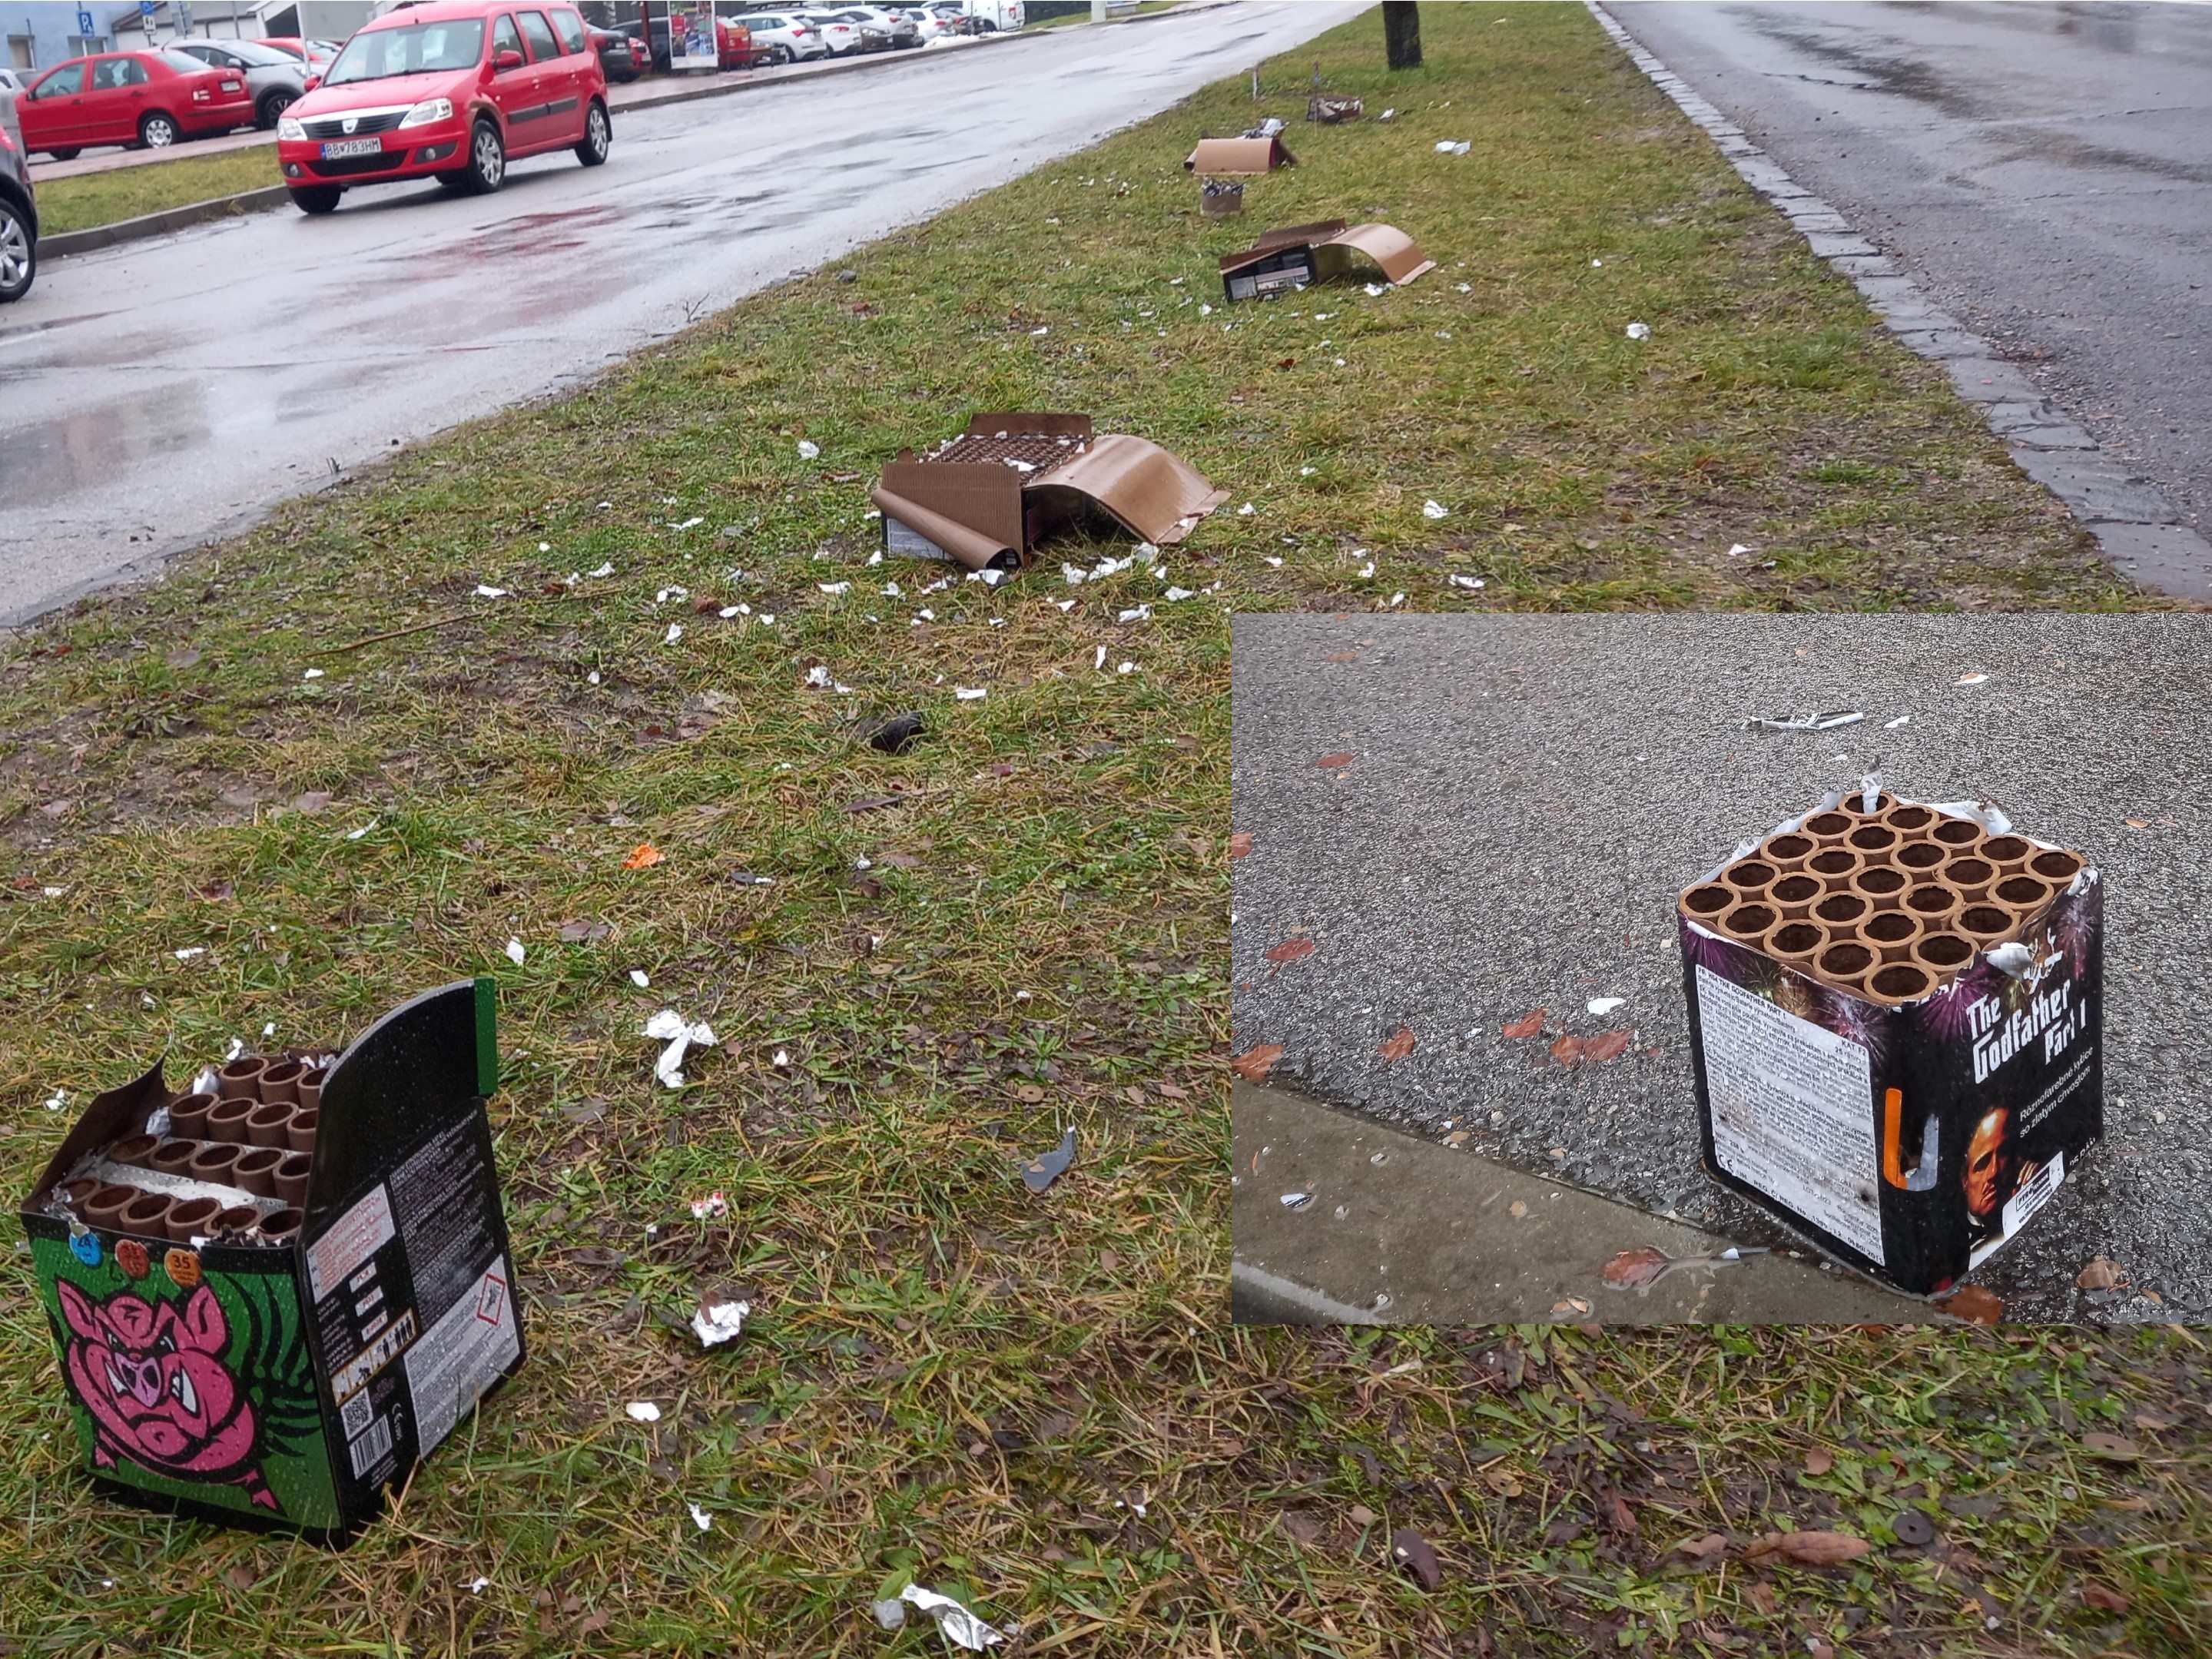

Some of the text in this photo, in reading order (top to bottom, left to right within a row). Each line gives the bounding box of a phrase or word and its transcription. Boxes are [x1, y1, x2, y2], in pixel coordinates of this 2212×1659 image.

[1966, 994, 2001, 1040] The
[1973, 979, 2071, 1084] Godfather
[2045, 1008, 2074, 1065] Part
[2020, 1047, 2093, 1122] Rôznofarebné kytice
[2020, 1066, 2091, 1138] so zlatým chvostom
[173, 1255, 191, 1269] 35
